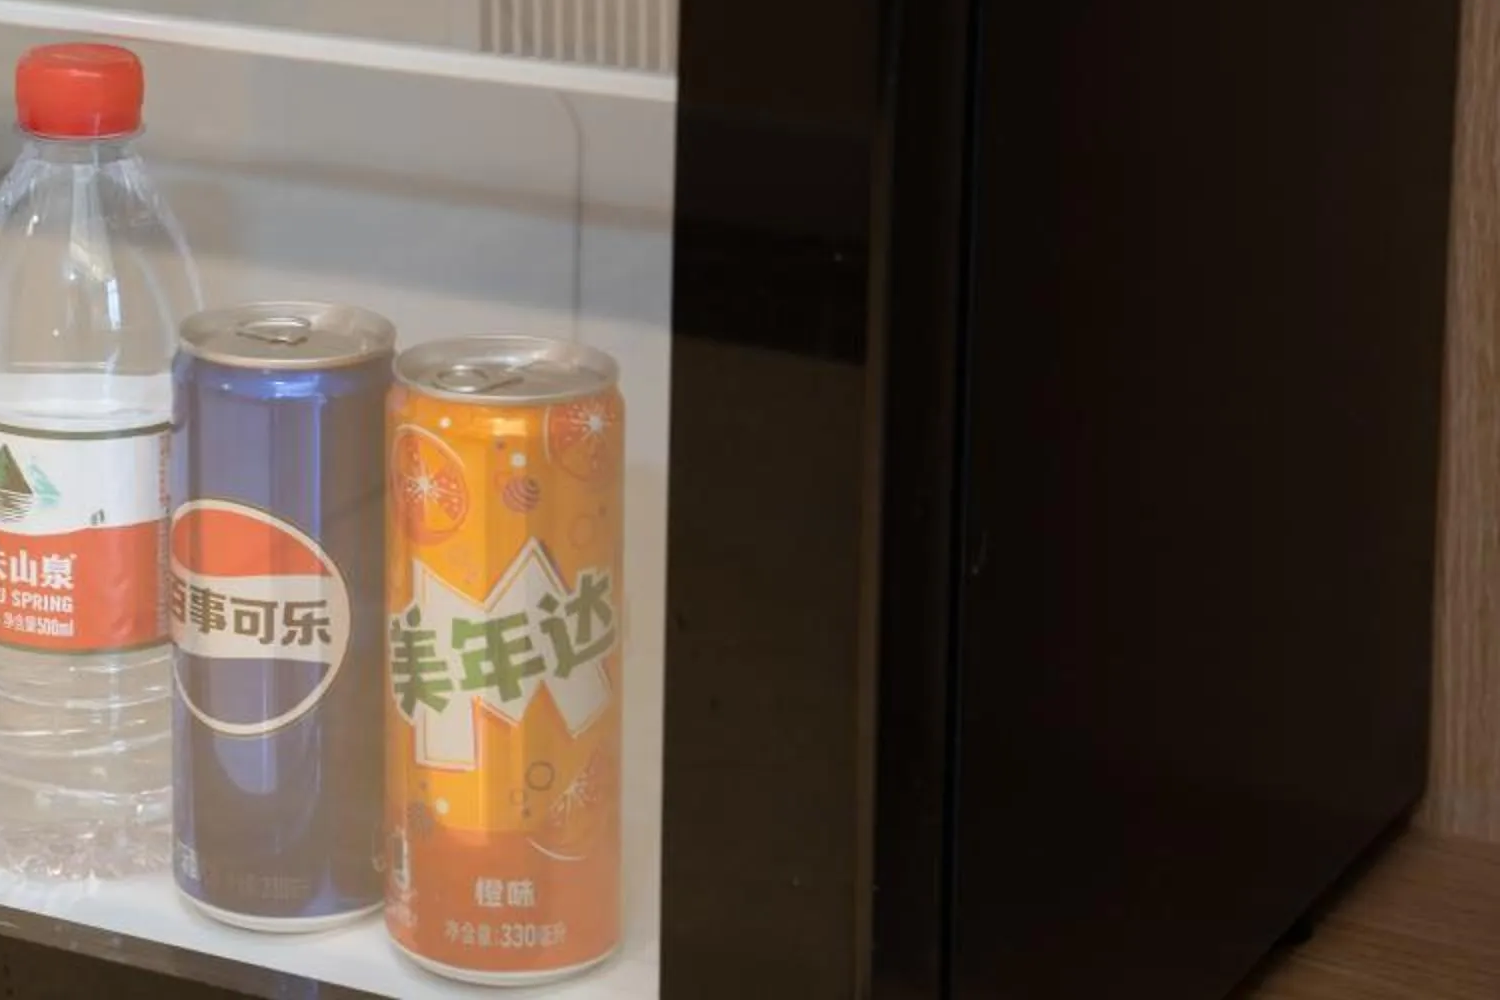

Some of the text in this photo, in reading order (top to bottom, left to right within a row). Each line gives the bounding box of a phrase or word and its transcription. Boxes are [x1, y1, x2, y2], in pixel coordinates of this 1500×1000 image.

[11, 589, 74, 614] SPRING
[390, 573, 616, 717] 美年达
[474, 876, 536, 908] 橙味
